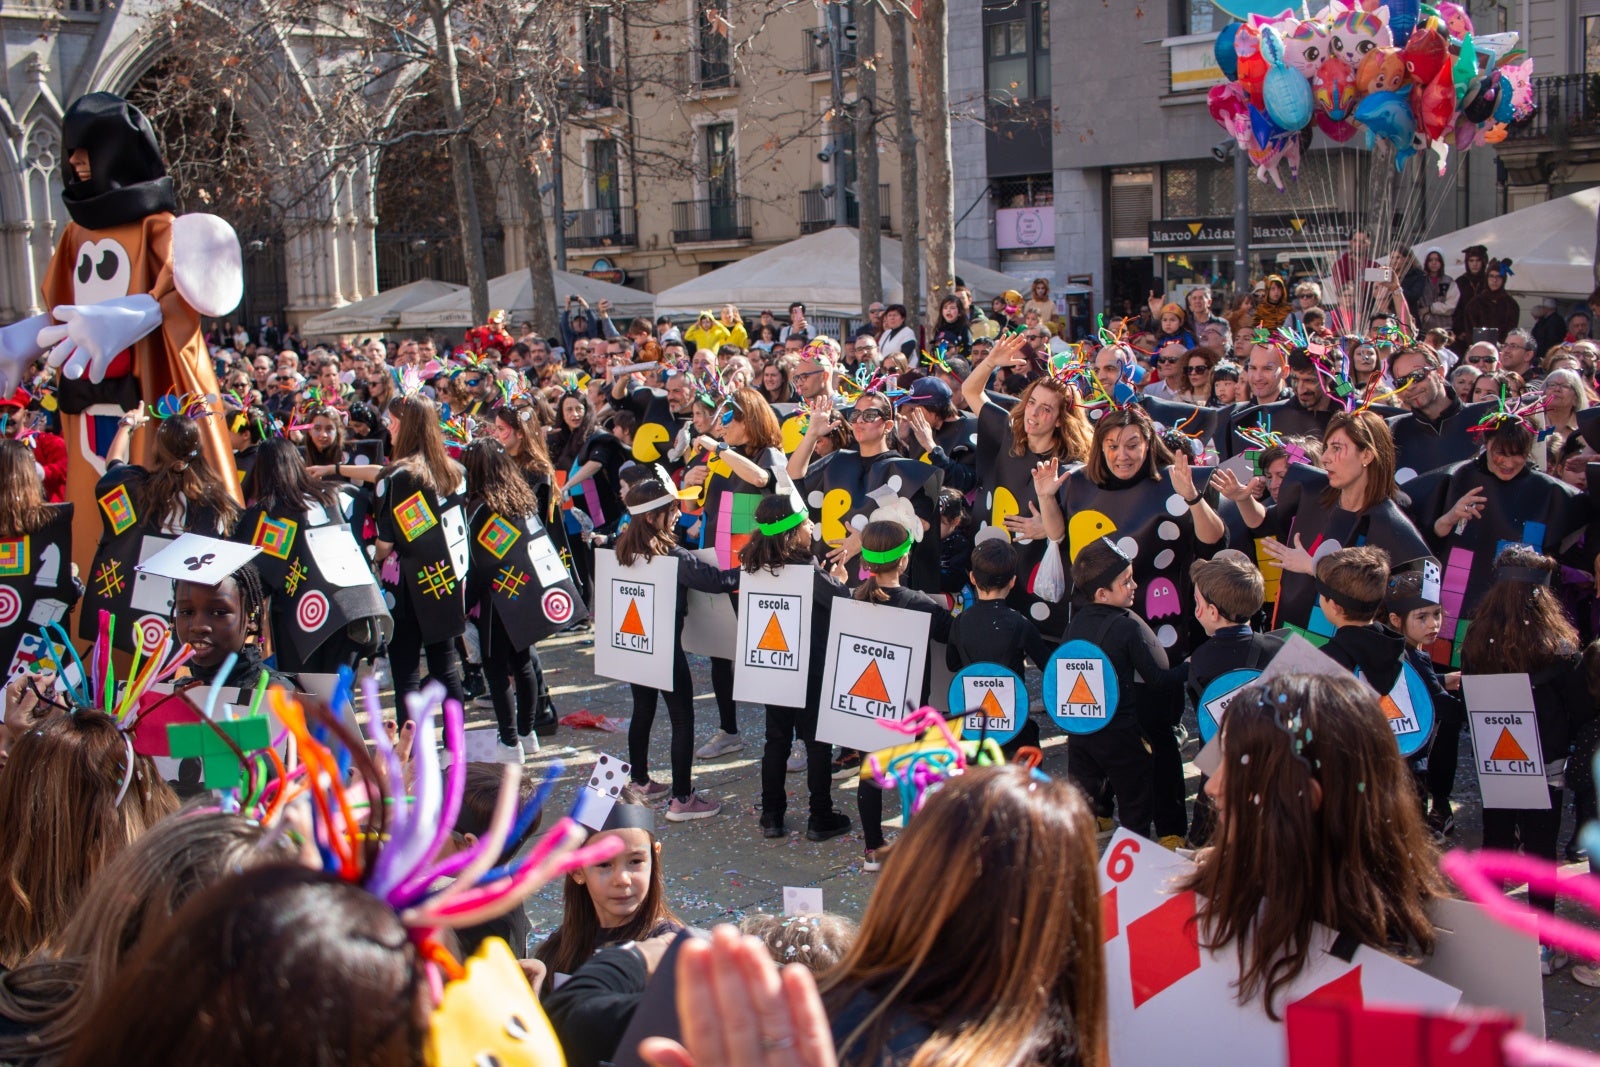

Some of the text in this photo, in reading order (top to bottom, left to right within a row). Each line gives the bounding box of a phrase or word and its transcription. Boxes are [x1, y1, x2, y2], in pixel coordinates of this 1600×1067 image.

[1152, 228, 1236, 242] Marco Aldan
[1252, 226, 1294, 238] Marco
[619, 585, 646, 598] escola
[758, 597, 790, 611] escola
[615, 632, 649, 650] EL CIM
[750, 649, 794, 667] EL CIM
[852, 643, 895, 661] escola
[1065, 660, 1095, 671] escola
[973, 678, 1005, 688] escola
[838, 694, 897, 719] EL CIM
[1060, 704, 1102, 716] EL CIM
[970, 718, 1010, 729] EL CIM
[1484, 714, 1523, 725] escola
[1483, 760, 1536, 773] EL CIM
[1106, 837, 1141, 883] 6
